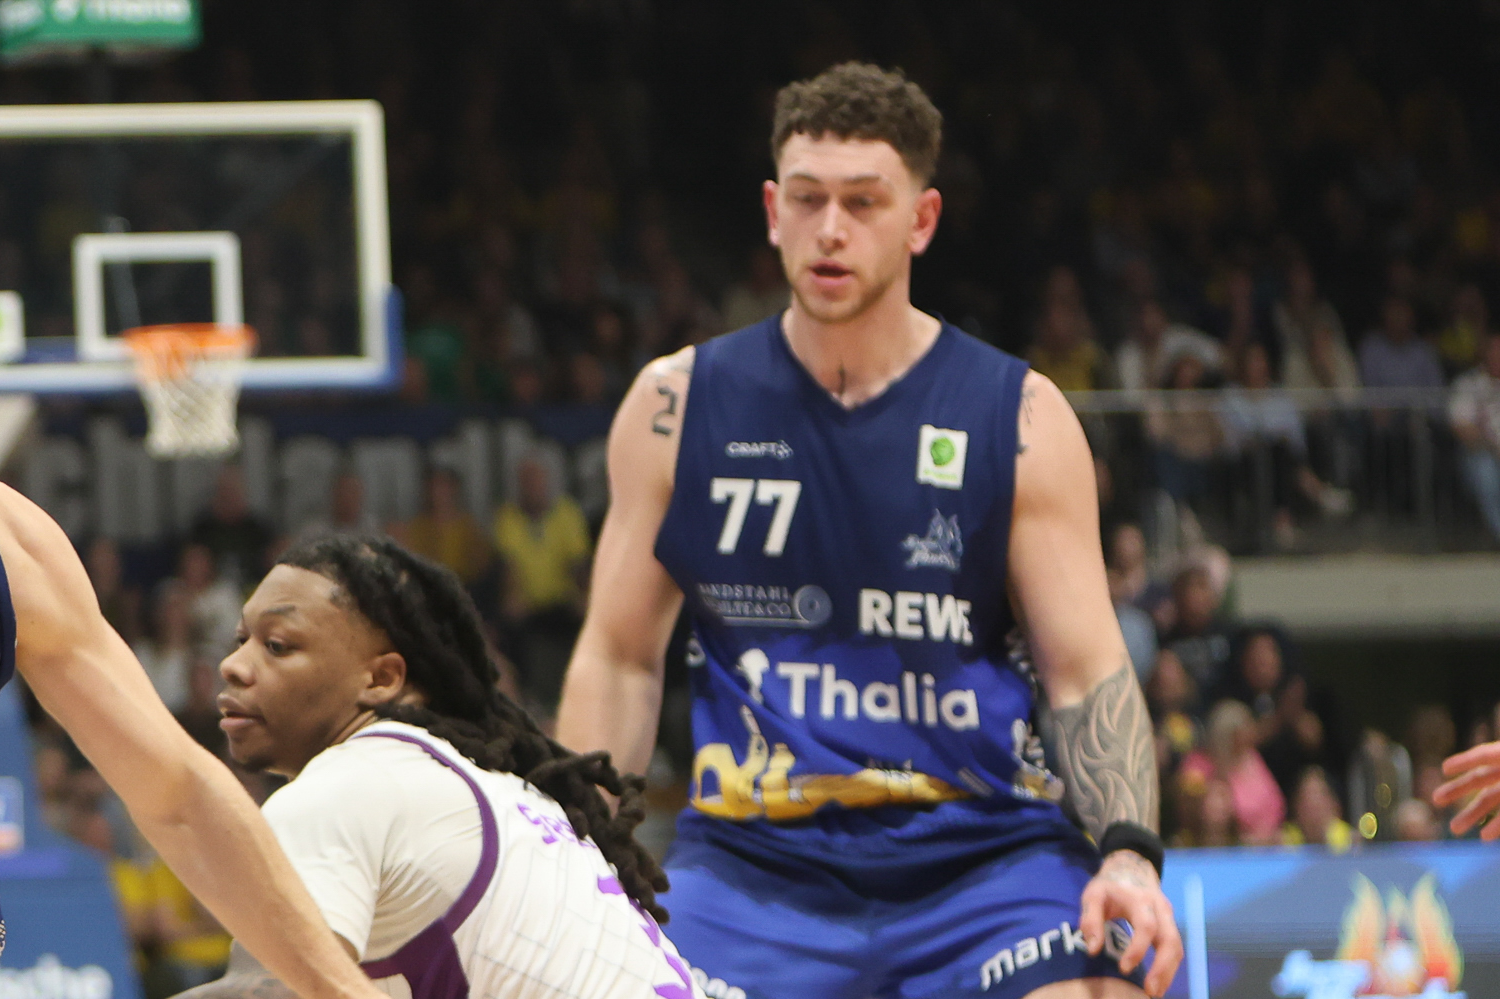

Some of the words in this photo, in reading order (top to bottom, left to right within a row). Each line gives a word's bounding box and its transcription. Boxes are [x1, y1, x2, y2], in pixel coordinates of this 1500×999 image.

[711, 477, 801, 556] 77
[776, 662, 980, 731] Thalia
[979, 921, 1088, 992] mark
